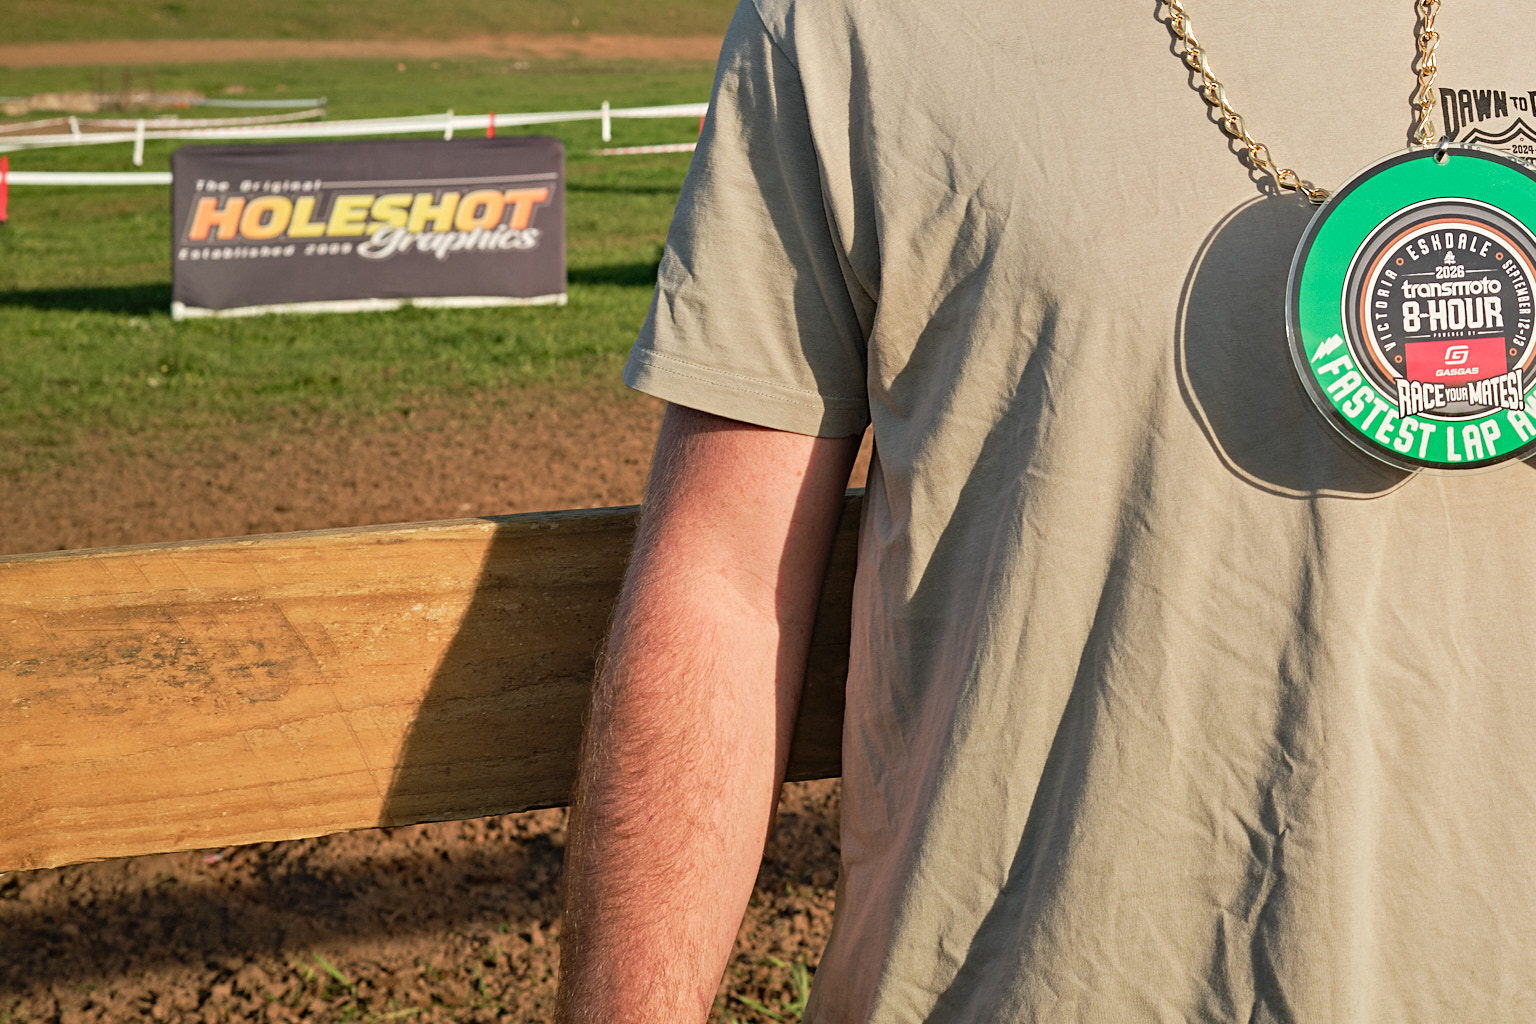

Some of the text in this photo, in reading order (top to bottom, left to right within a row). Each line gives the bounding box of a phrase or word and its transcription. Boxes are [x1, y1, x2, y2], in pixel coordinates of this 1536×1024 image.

[1438, 88, 1508, 143] DAWN
[1509, 96, 1528, 111] TO
[1512, 144, 1535, 155] 2024
[195, 178, 322, 195] The Original
[189, 188, 550, 241] HOLESHOT
[178, 244, 296, 261] Established
[1406, 232, 1492, 262] ESKDALE
[1401, 276, 1502, 299] transmoto
[1435, 264, 1466, 280] 2026
[1375, 269, 1398, 352] VICTORIA
[1402, 296, 1504, 333] 8-HOUR
[1502, 259, 1532, 347] SEPTEMBER 12-13
[1436, 367, 1480, 377] GASGAS
[1396, 369, 1524, 418] RACE YOUR MATES!
[1316, 359, 1436, 460] FASTEST
[1447, 422, 1501, 462] LAP
